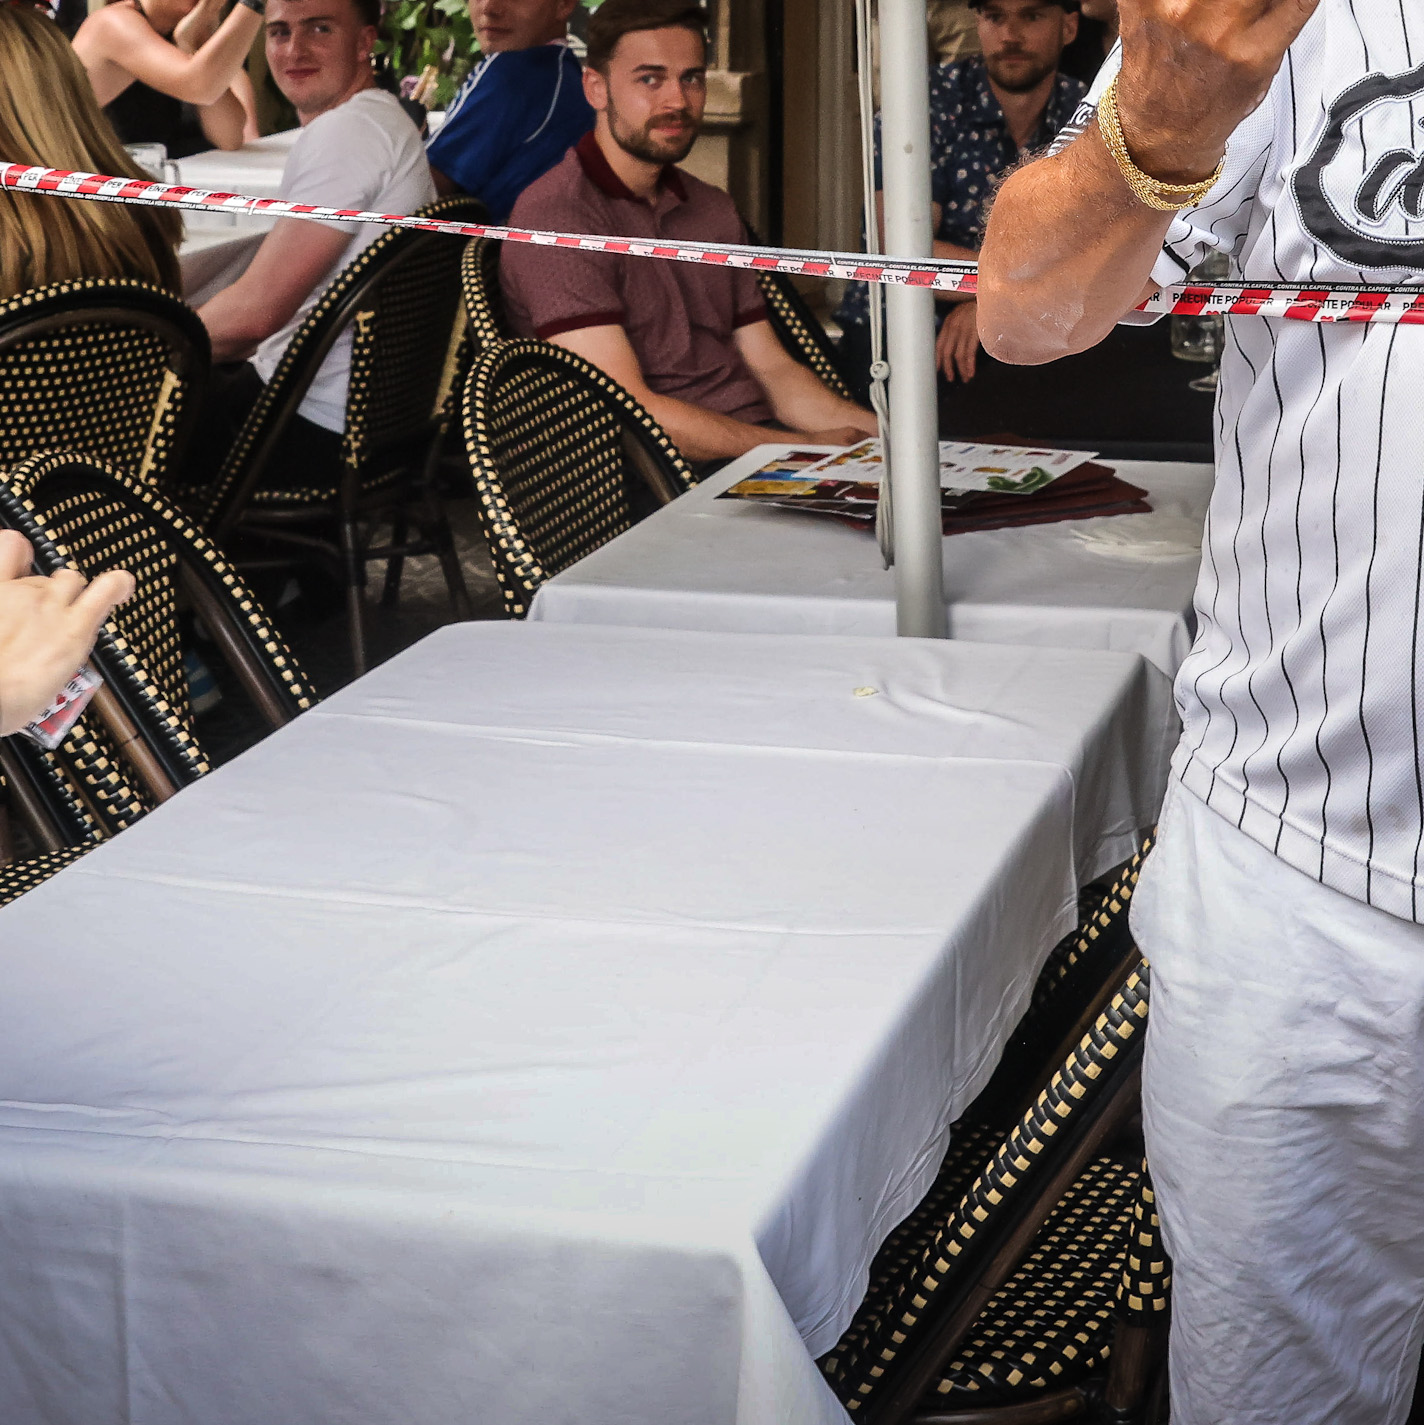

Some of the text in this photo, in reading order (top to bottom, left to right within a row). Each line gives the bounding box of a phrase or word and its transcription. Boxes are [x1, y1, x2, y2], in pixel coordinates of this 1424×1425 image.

[847, 271, 894, 282] PRECINTE
[896, 275, 942, 287] POPULAR
[1172, 292, 1222, 305] PRECINTE
[1341, 300, 1391, 311] POPULAR
